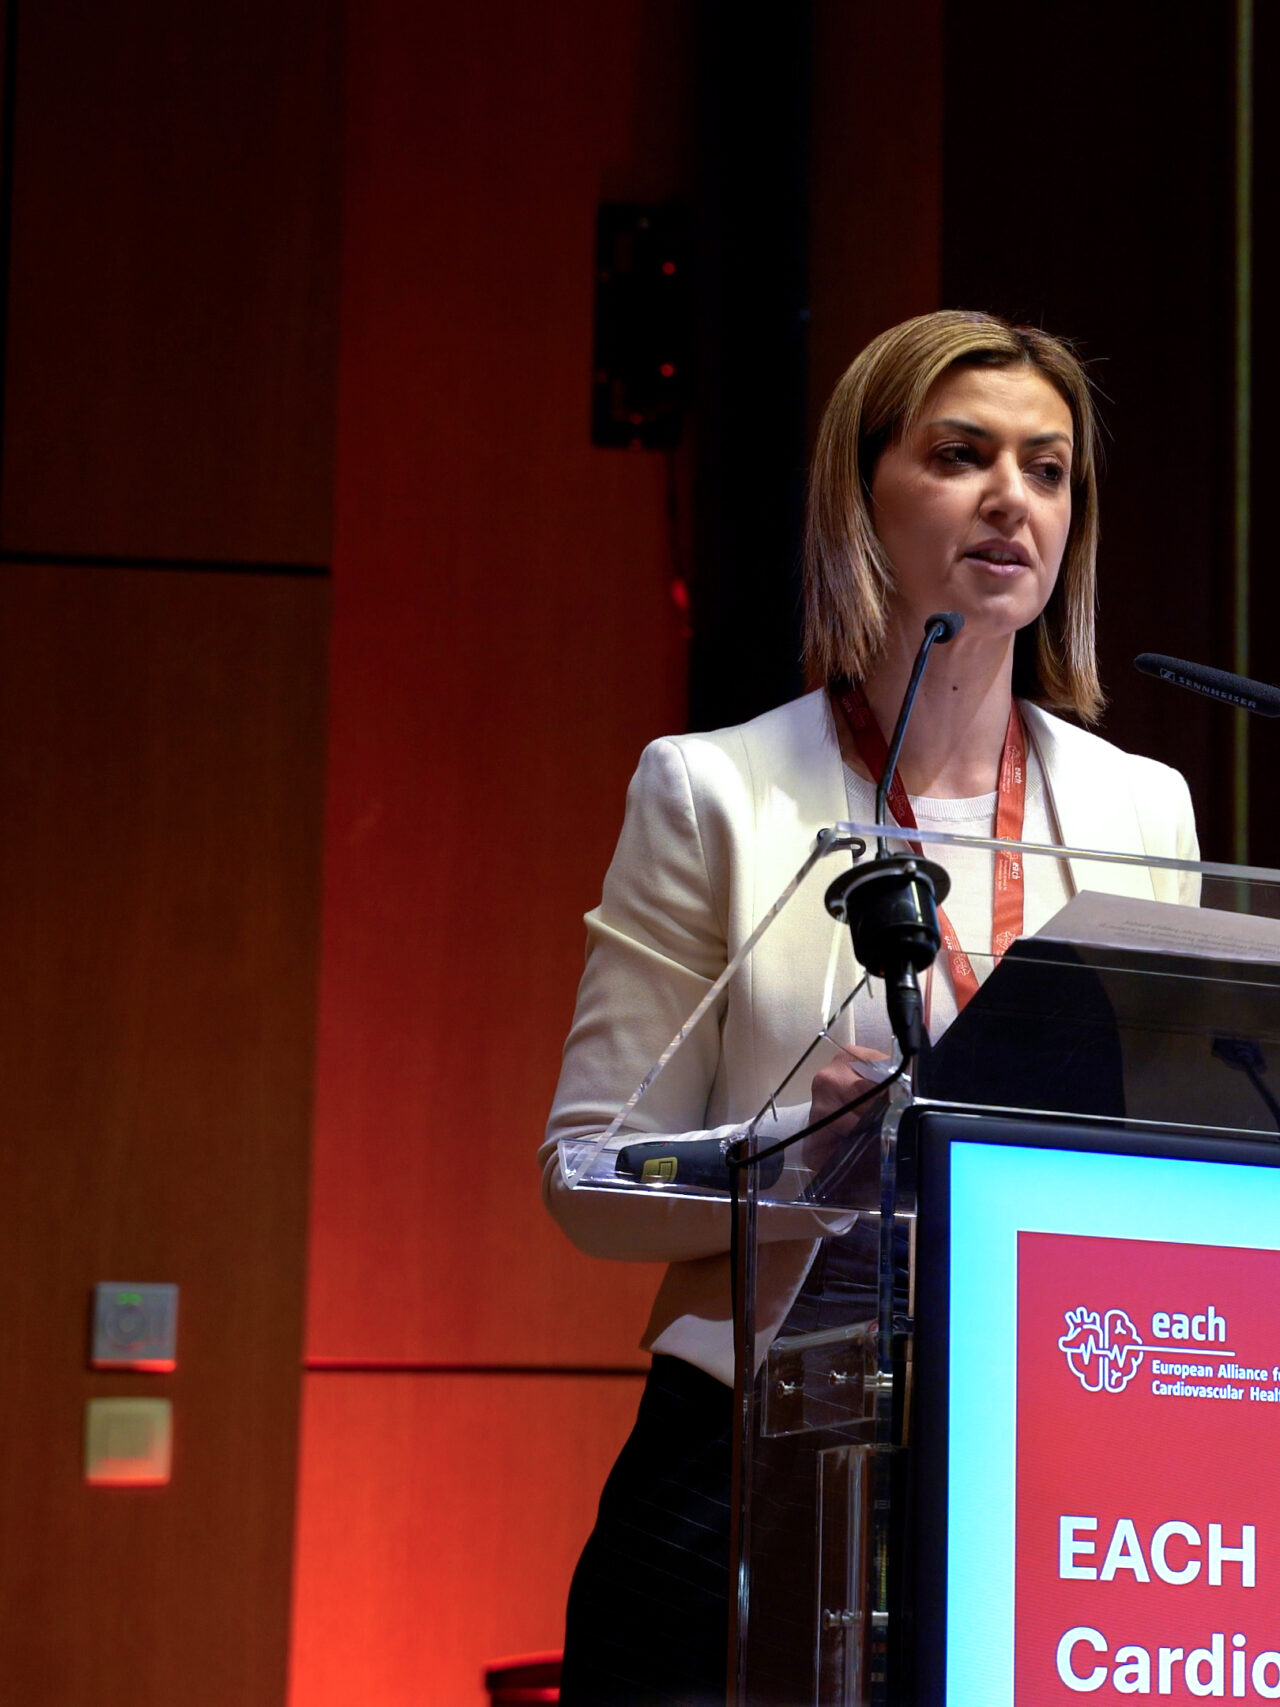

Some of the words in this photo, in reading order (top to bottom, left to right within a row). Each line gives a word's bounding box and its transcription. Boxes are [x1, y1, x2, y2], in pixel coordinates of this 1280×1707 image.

[1178, 677, 1257, 708] SENNHEISER
[1152, 1306, 1226, 1342] each
[1152, 1360, 1213, 1379] European
[1218, 1364, 1268, 1381] Alliance
[1152, 1381, 1244, 1400] Cardiovascular
[1058, 1515, 1257, 1588] EACH
